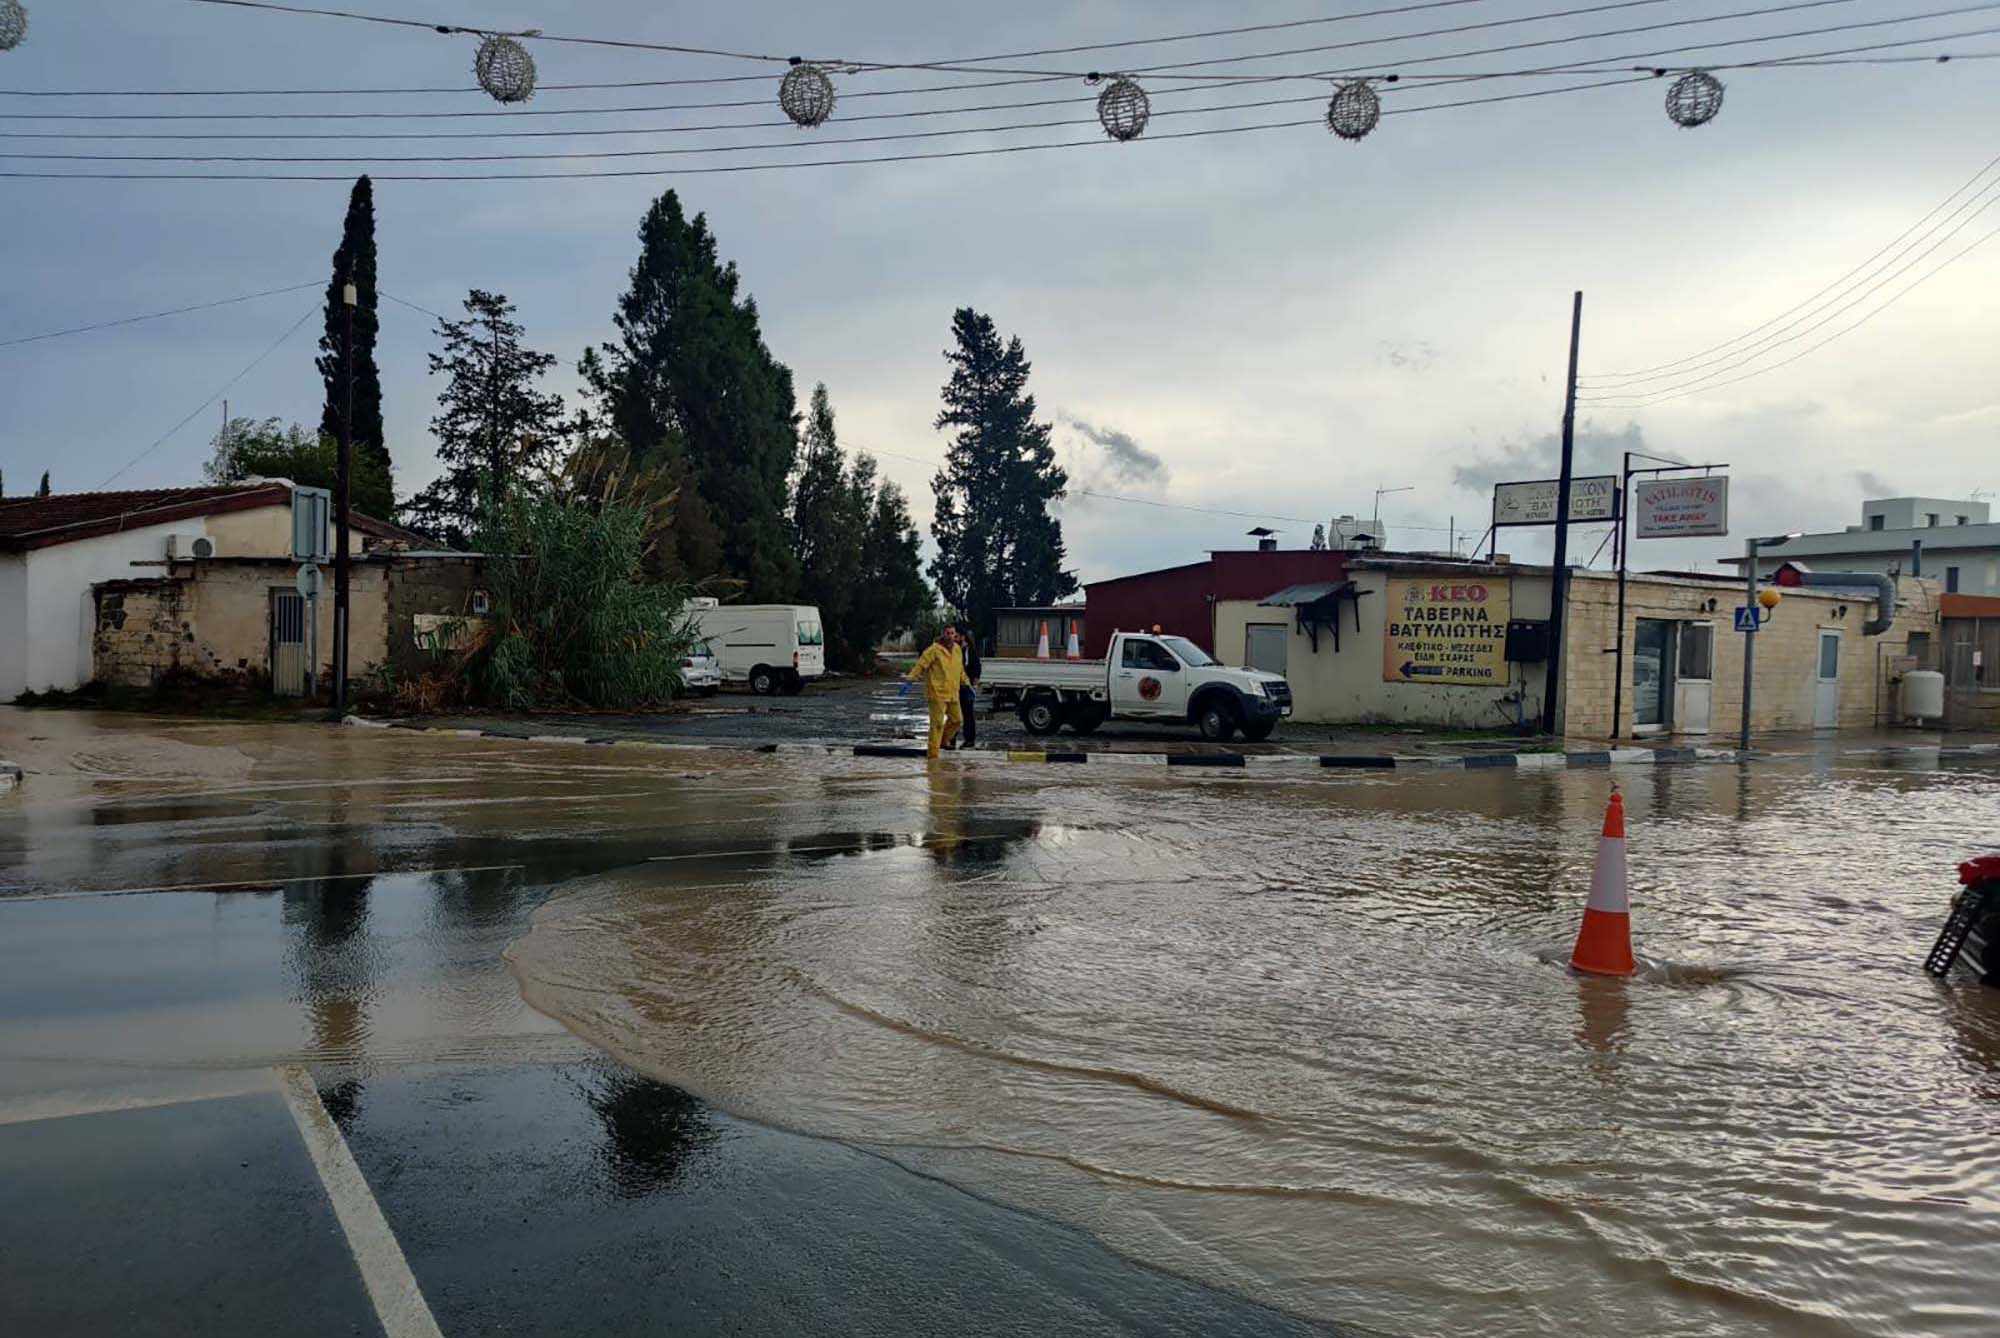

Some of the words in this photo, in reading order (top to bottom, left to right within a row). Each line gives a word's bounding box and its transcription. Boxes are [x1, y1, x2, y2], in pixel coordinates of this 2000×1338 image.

[1430, 584, 1488, 603] KEO
[1404, 607, 1488, 622] ΤΑΒΕΡΝΑ
[1389, 623, 1505, 639] ΒΑΤΥΛΙΩΤΗΣ
[1446, 666, 1493, 678] PARKING
